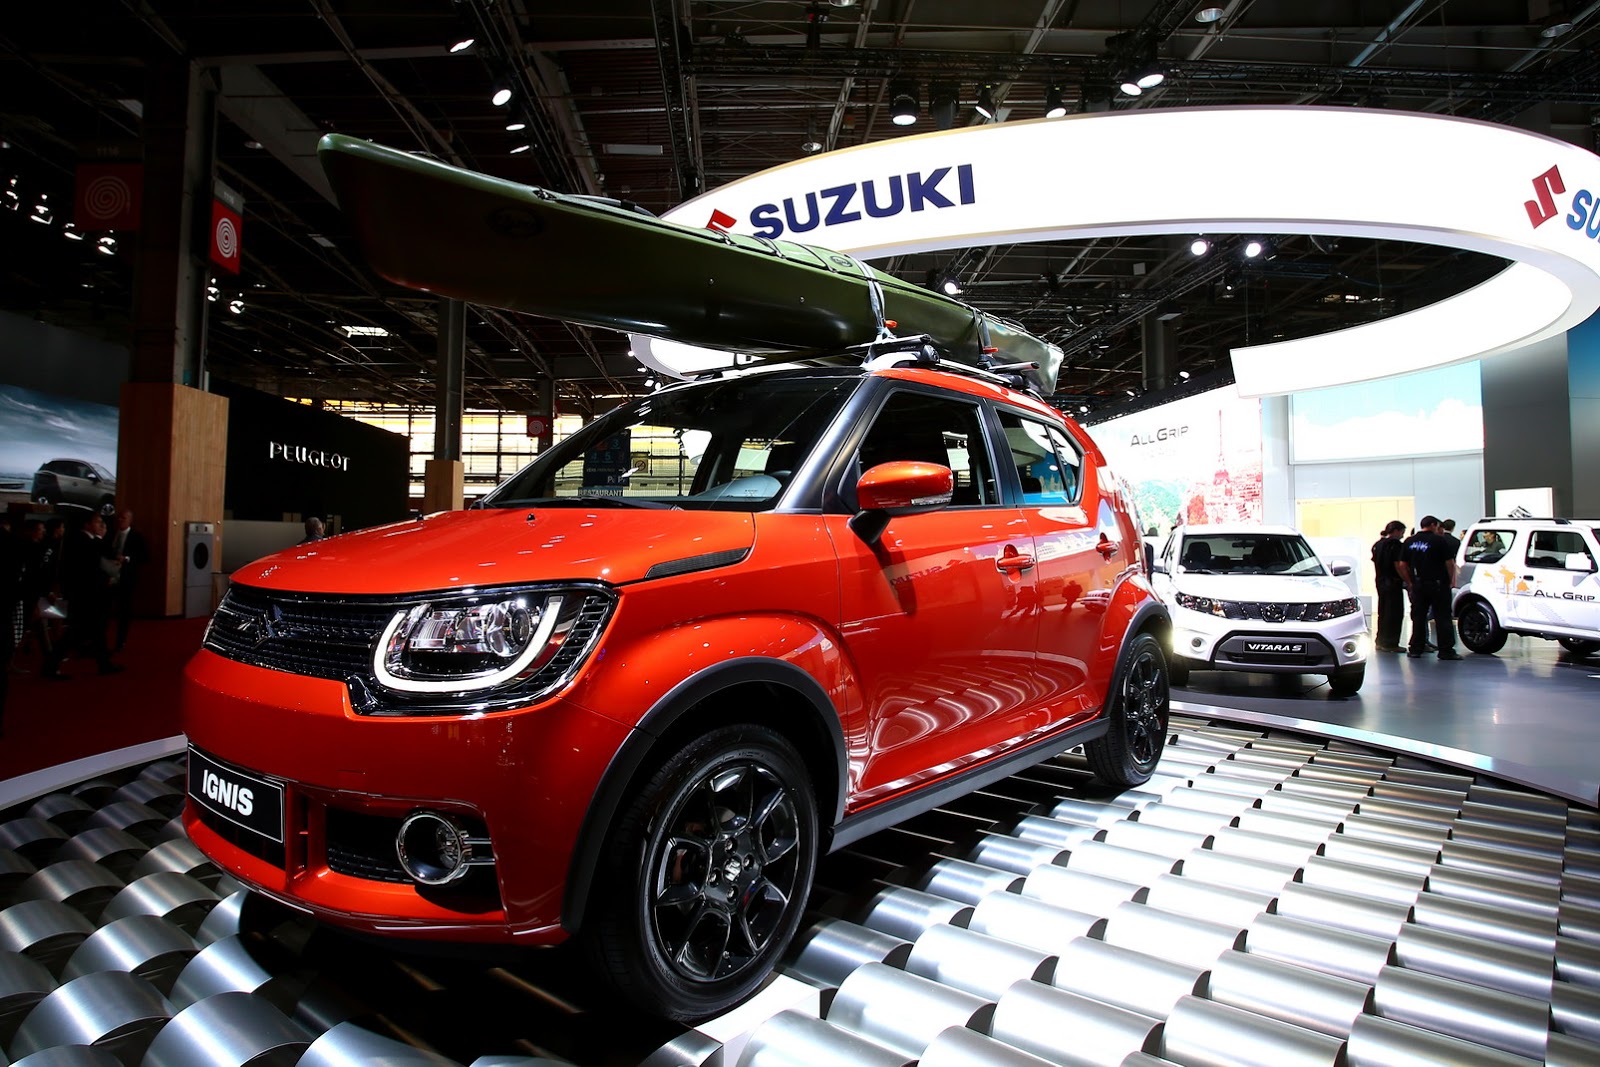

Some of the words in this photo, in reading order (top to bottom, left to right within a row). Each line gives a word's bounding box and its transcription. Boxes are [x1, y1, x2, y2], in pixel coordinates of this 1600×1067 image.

[749, 163, 976, 240] SUZUKI
[1566, 189, 1600, 244] SU
[269, 440, 351, 471] PEUGEOT
[578, 489, 623, 497] RESTAURANT
[1248, 643, 1290, 651] VITARA
[202, 769, 254, 816] IGNIS
